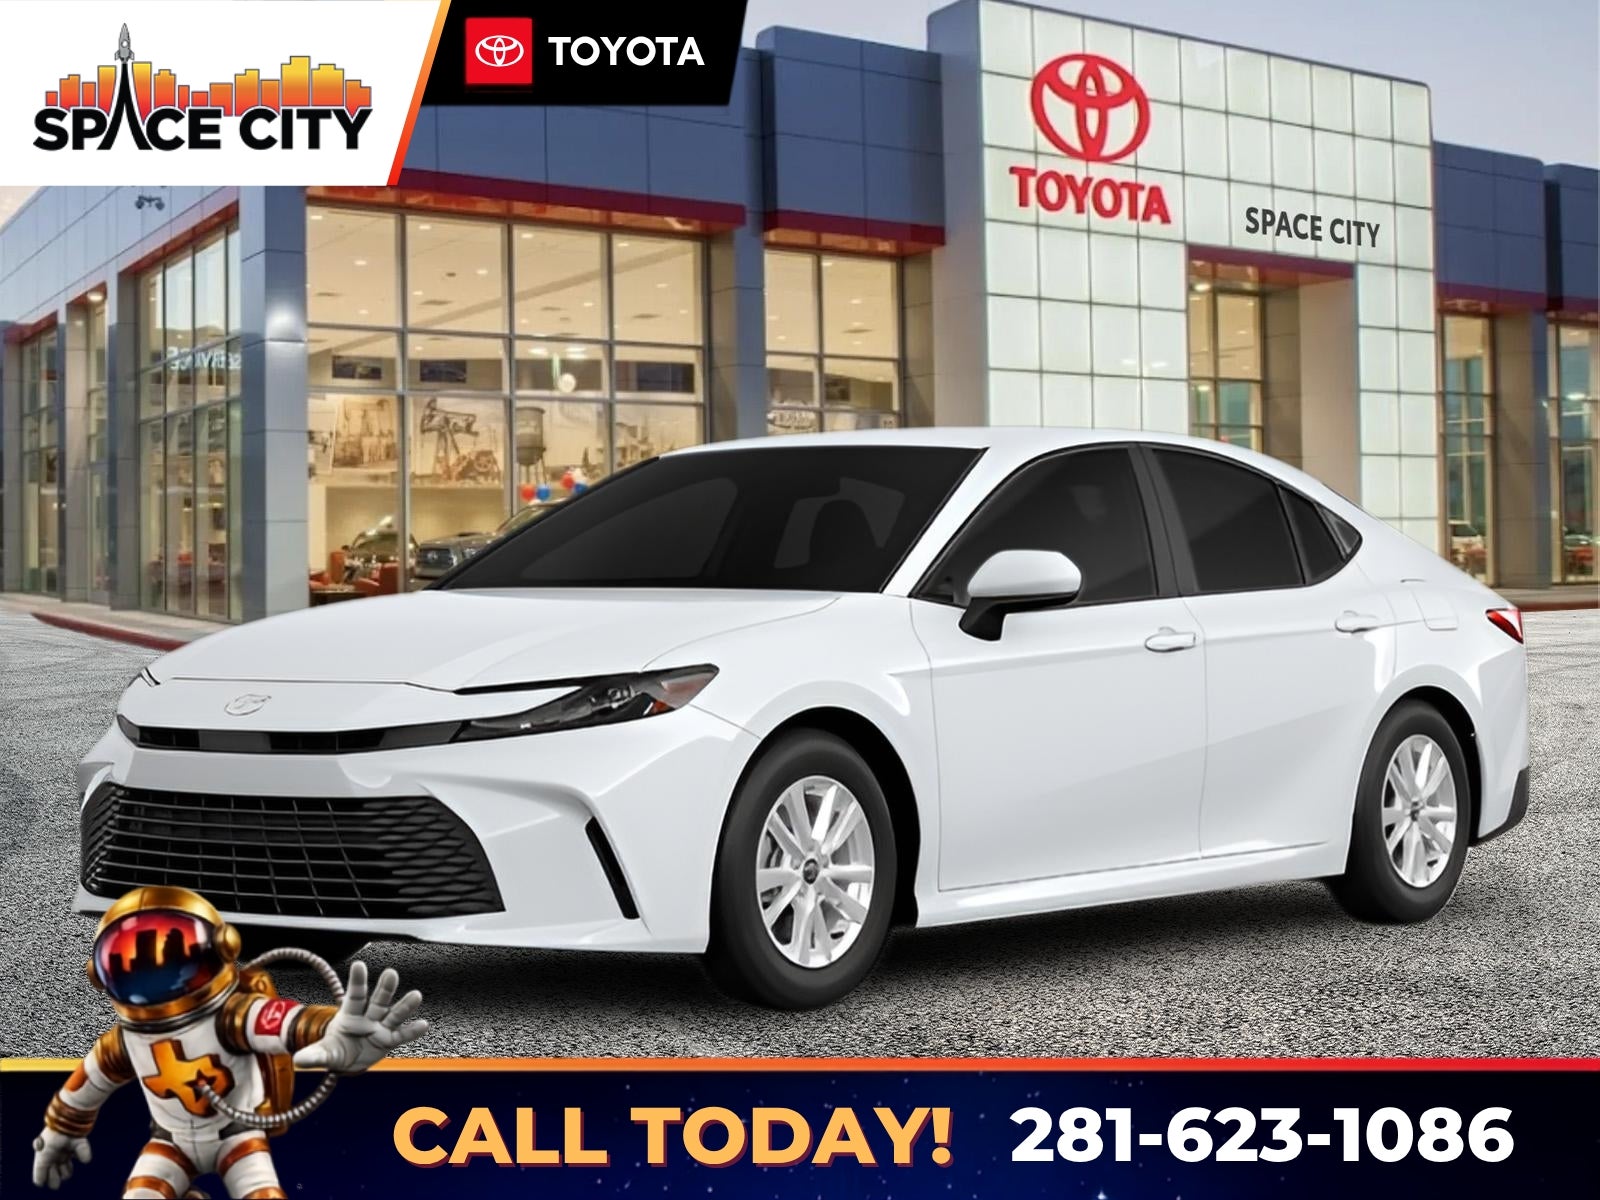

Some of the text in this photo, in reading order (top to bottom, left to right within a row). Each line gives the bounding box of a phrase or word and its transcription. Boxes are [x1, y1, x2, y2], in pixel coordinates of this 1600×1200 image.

[1009, 166, 1171, 225] TOYOTA
[1245, 206, 1381, 248] SPACE CITY
